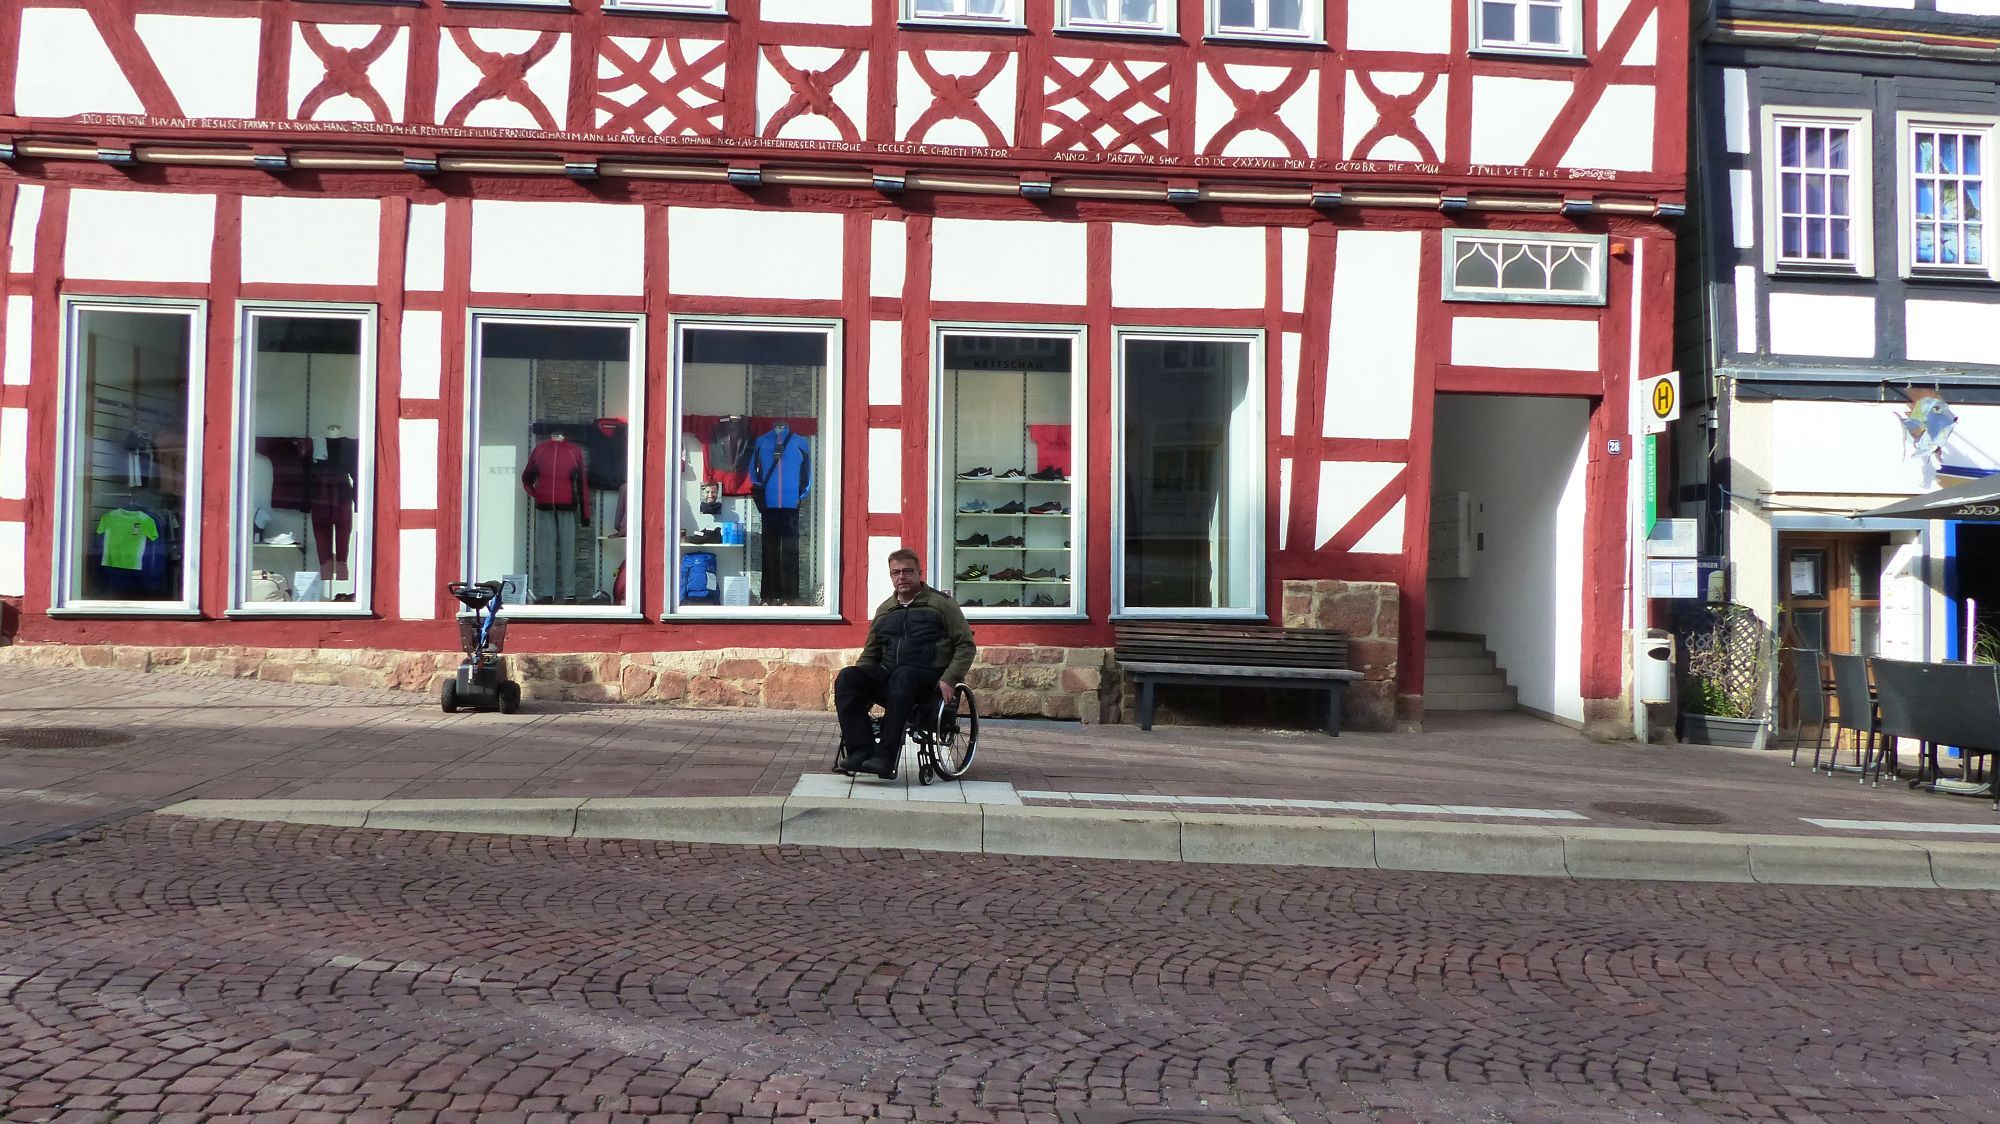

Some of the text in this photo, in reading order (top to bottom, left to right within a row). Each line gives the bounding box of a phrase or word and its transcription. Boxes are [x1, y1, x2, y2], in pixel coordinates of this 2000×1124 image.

[106, 115, 146, 126] BENIGNE
[278, 121, 292, 130] EX
[931, 145, 967, 157] CHRISTI
[1388, 164, 1404, 172] DIE
[974, 360, 1043, 369] KETTSCHAU
[1658, 386, 1669, 410] H
[1609, 441, 1620, 452] 28
[1647, 444, 1656, 502] Marktplatz
